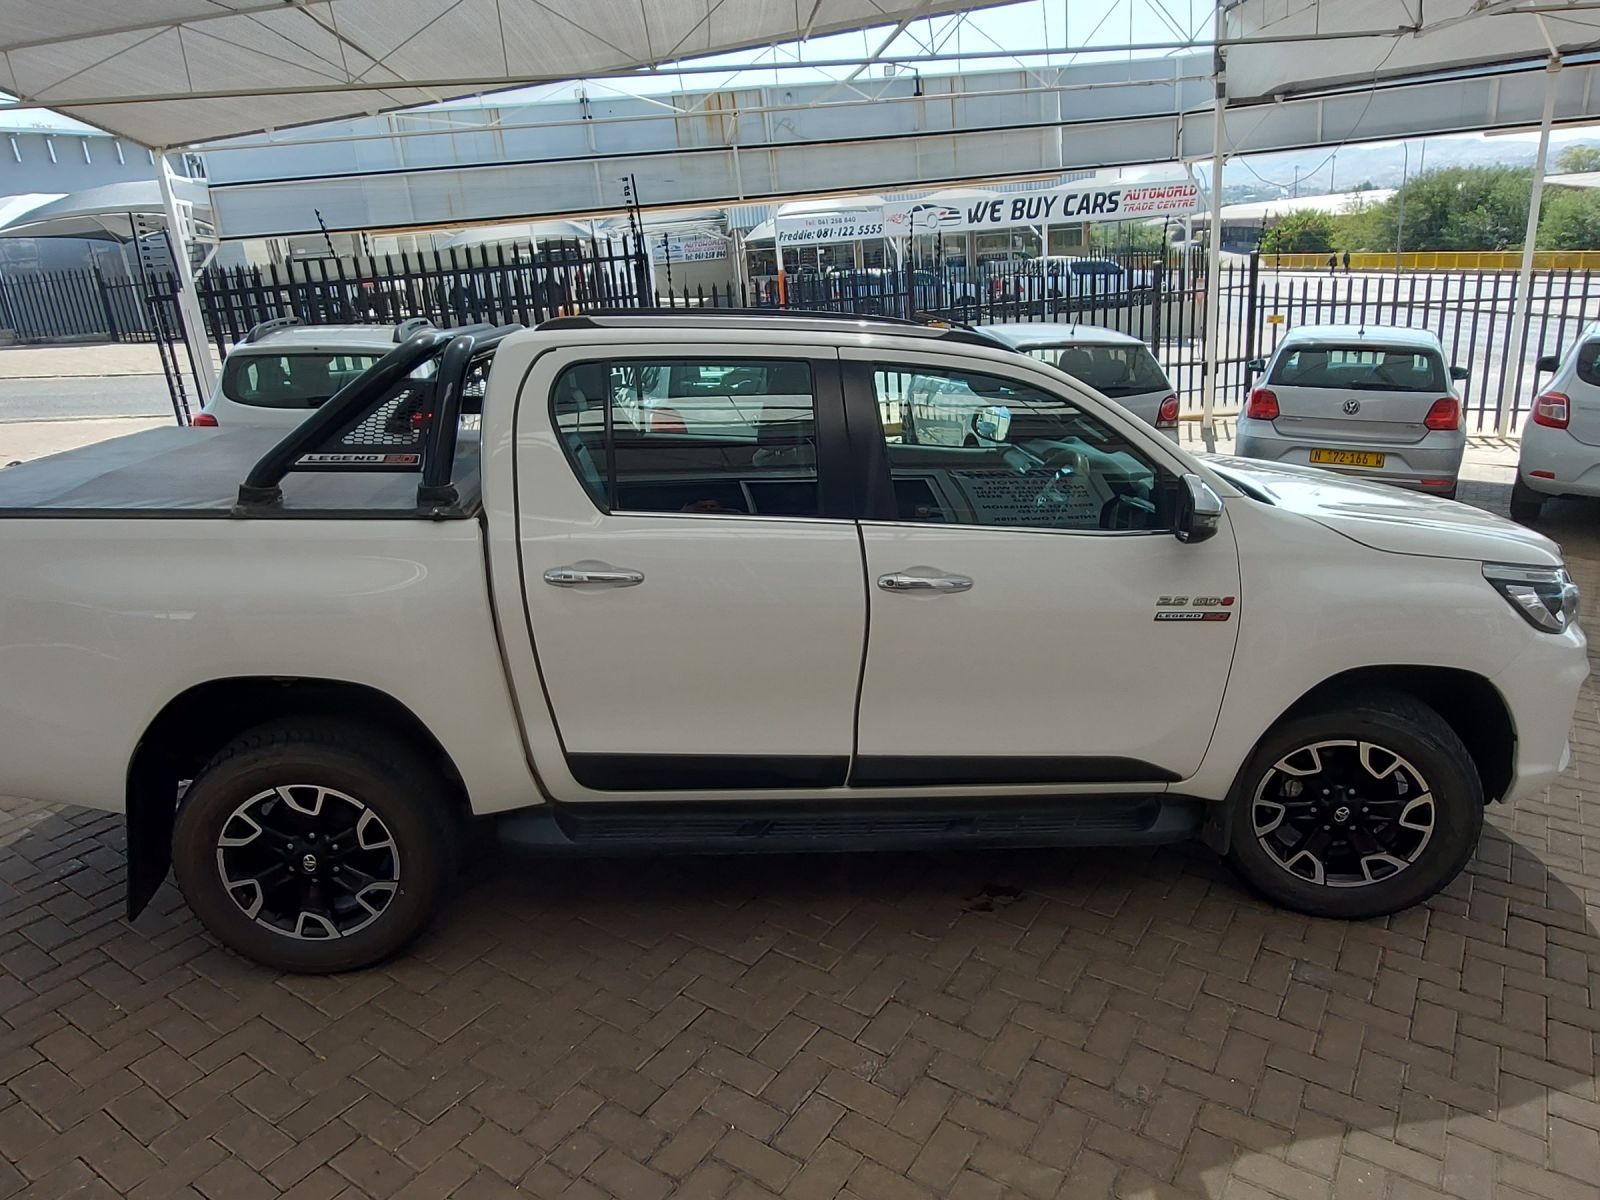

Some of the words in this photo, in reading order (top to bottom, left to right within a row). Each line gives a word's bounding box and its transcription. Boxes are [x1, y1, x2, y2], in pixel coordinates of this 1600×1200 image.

[1123, 184, 1198, 201] AUTOWORLD
[967, 199, 1004, 224] WE
[1010, 195, 1058, 221] BUY
[1063, 190, 1121, 217] CARS
[1123, 201, 1155, 212] TRADE
[1157, 198, 1196, 210] CENTRE
[778, 230, 815, 241] Freddie:
[816, 226, 855, 239] 081-122
[857, 224, 883, 235] 5555
[1314, 450, 1321, 461] N
[1375, 452, 1383, 466] W
